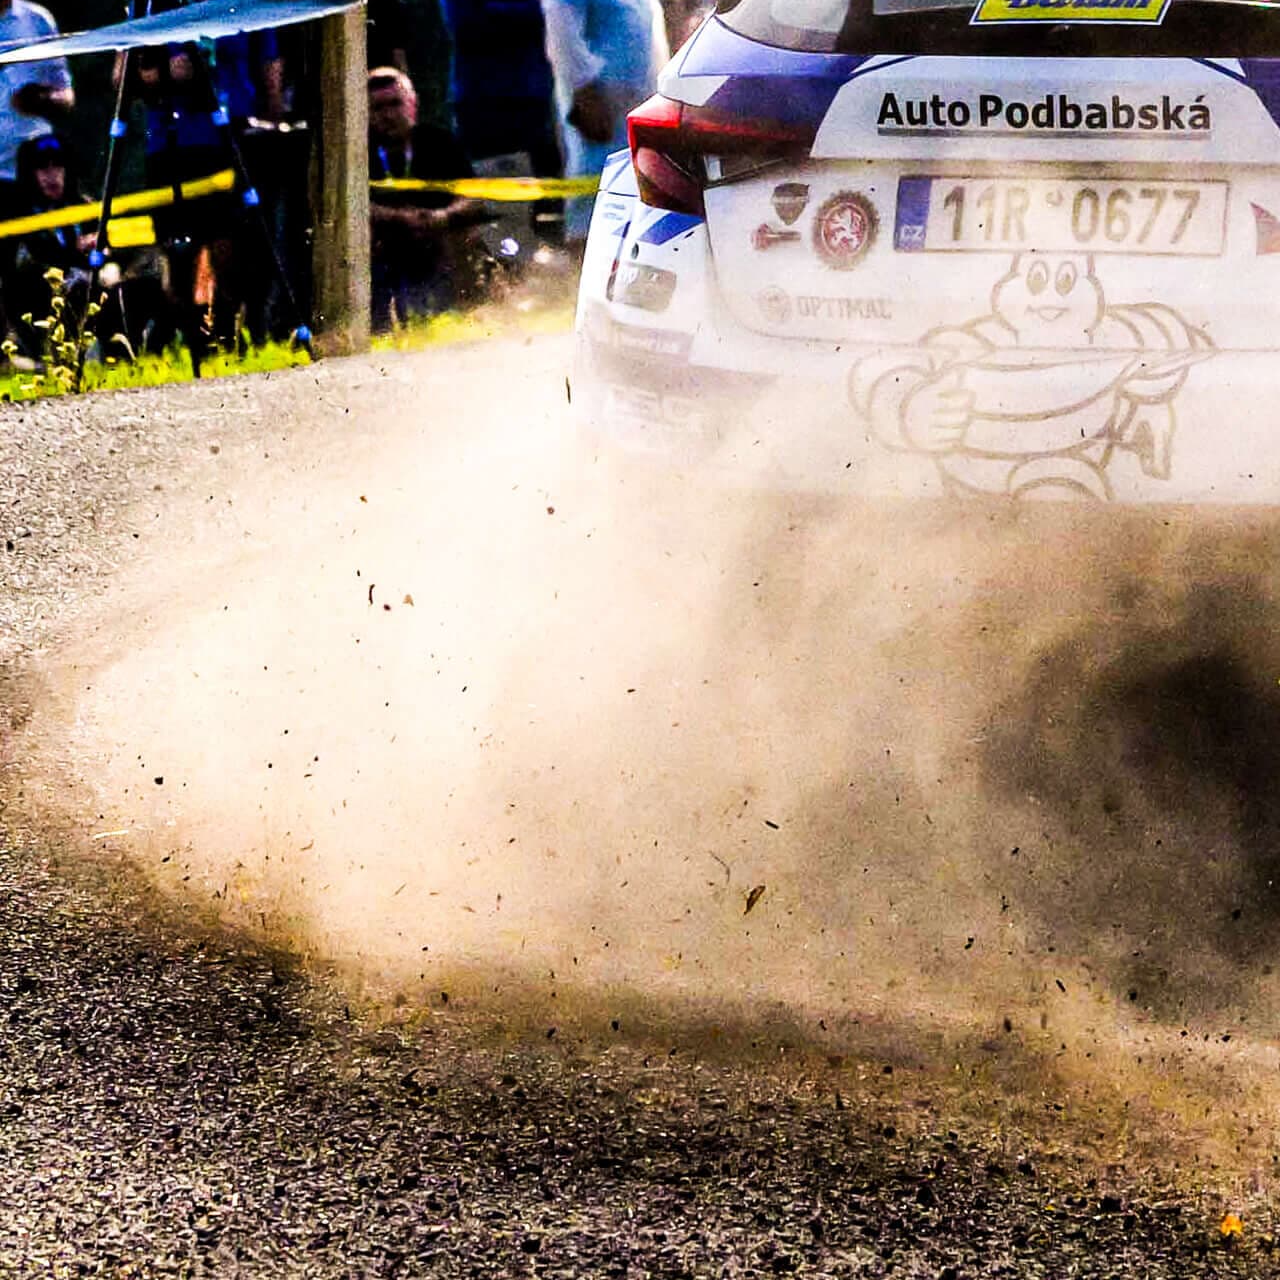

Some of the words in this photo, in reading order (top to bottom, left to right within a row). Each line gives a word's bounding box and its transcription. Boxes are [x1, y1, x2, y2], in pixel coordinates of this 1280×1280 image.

[877, 93, 971, 128] Auto
[979, 93, 1212, 131] Podbabská
[944, 185, 1030, 242] 11R
[1071, 186, 1201, 244] 0677
